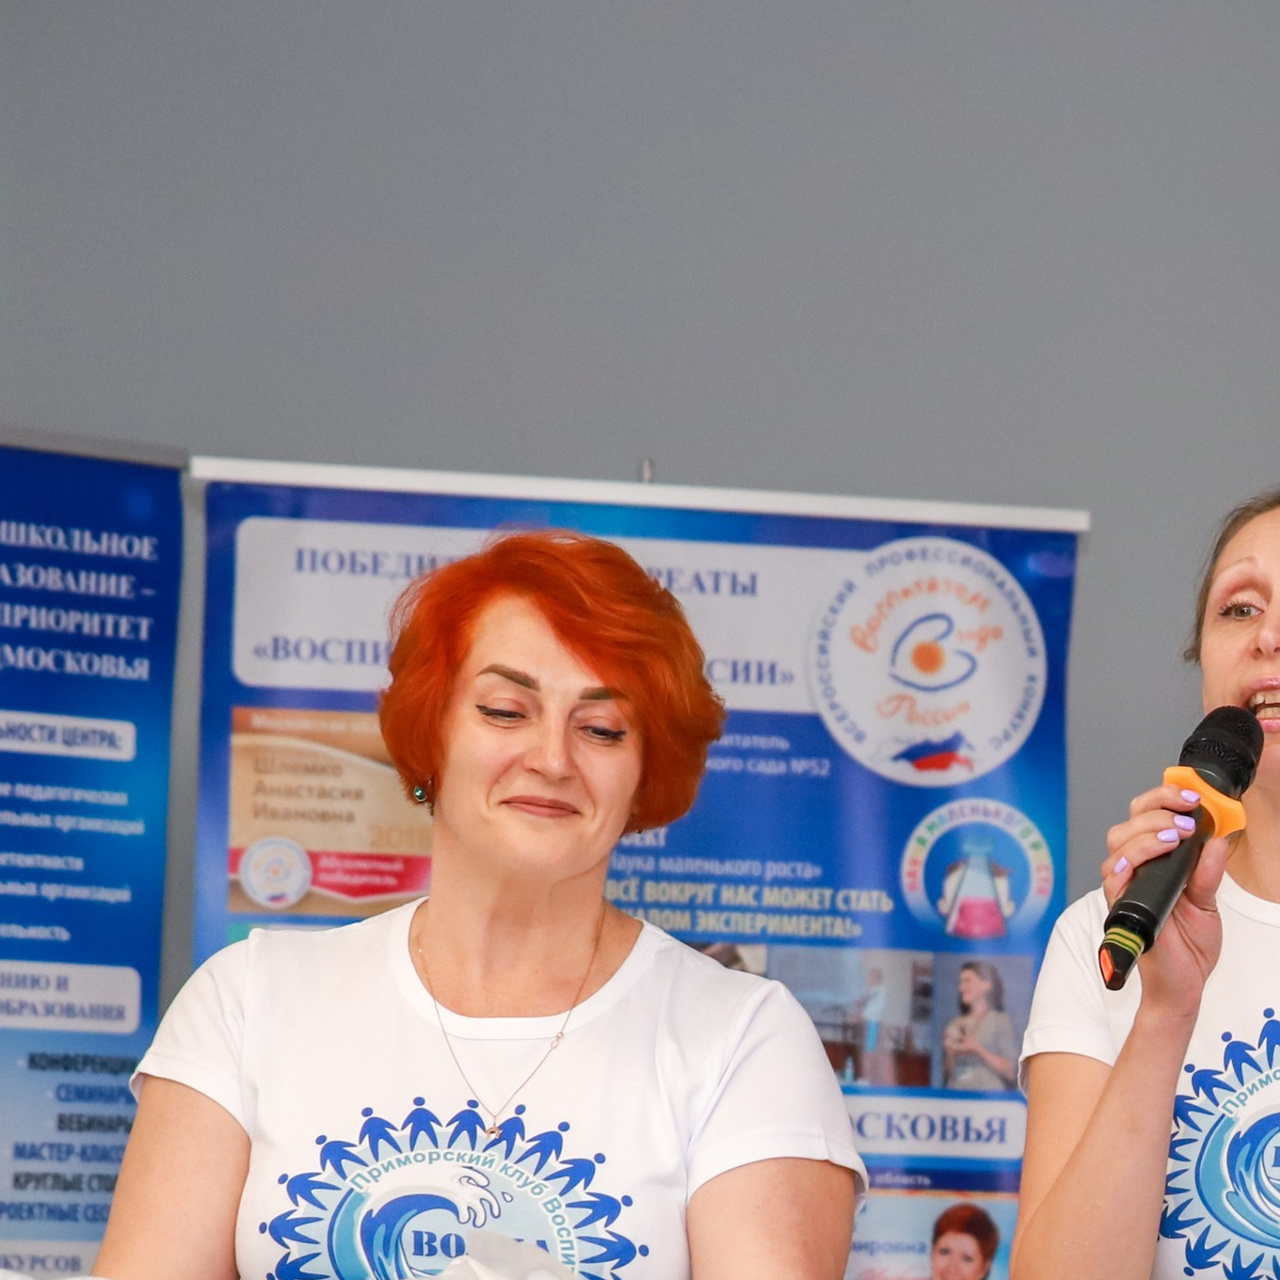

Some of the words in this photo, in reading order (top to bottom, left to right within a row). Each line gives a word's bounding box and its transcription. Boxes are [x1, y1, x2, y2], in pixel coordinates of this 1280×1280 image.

[0, 644, 149, 681] МОСКОВЬЯ
[645, 881, 717, 904] ВОКРУГ
[721, 885, 759, 907] НАС
[763, 887, 834, 911] МОЖЕТ
[836, 890, 894, 915] СТАТЬ
[851, 1111, 1008, 1144] СКОВЬЯ
[351, 1150, 496, 1192] Приморский
[500, 1162, 551, 1197] клуб
[542, 1196, 578, 1272] Воспи
[0, 1253, 81, 1274] КУРСОВ
